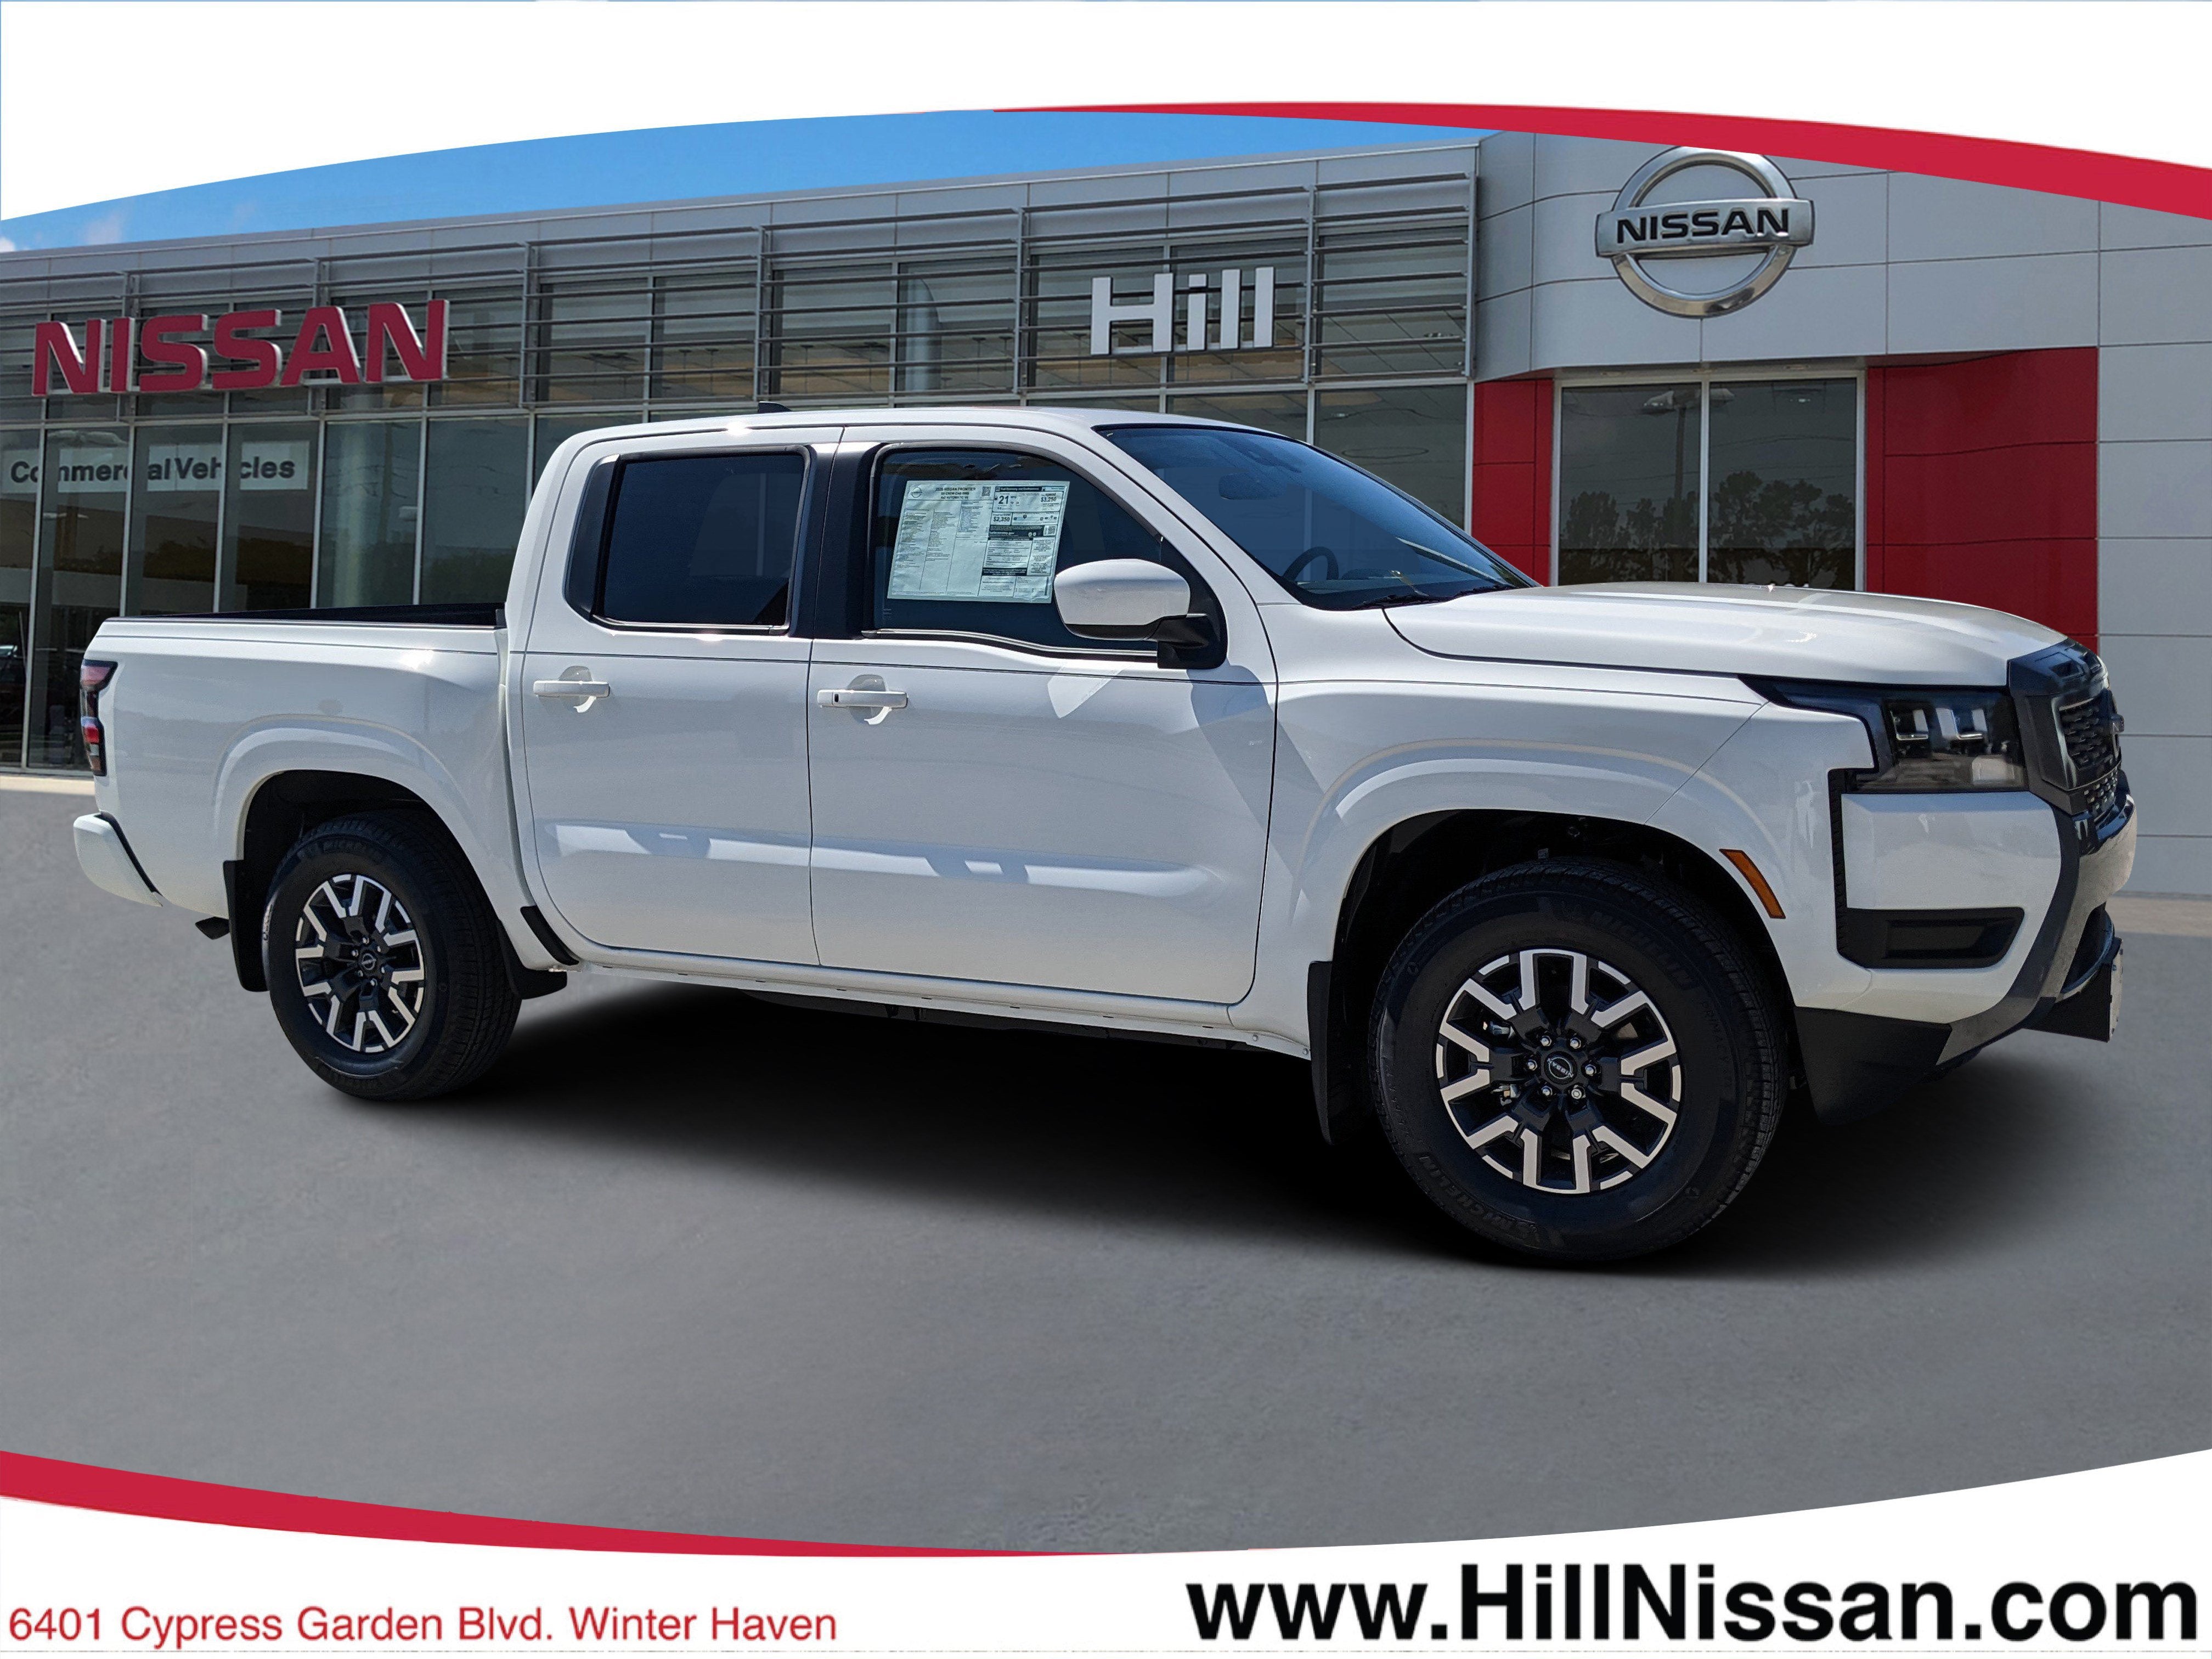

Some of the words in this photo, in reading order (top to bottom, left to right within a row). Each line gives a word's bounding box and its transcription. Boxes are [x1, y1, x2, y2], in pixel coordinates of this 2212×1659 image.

[1616, 207, 1790, 245] NISSAN
[1091, 266, 1274, 356] Hill
[32, 300, 449, 396] NISSAN
[10, 457, 171, 483] Commeral
[174, 456, 295, 481] Vehcles
[998, 495, 1009, 504] 21
